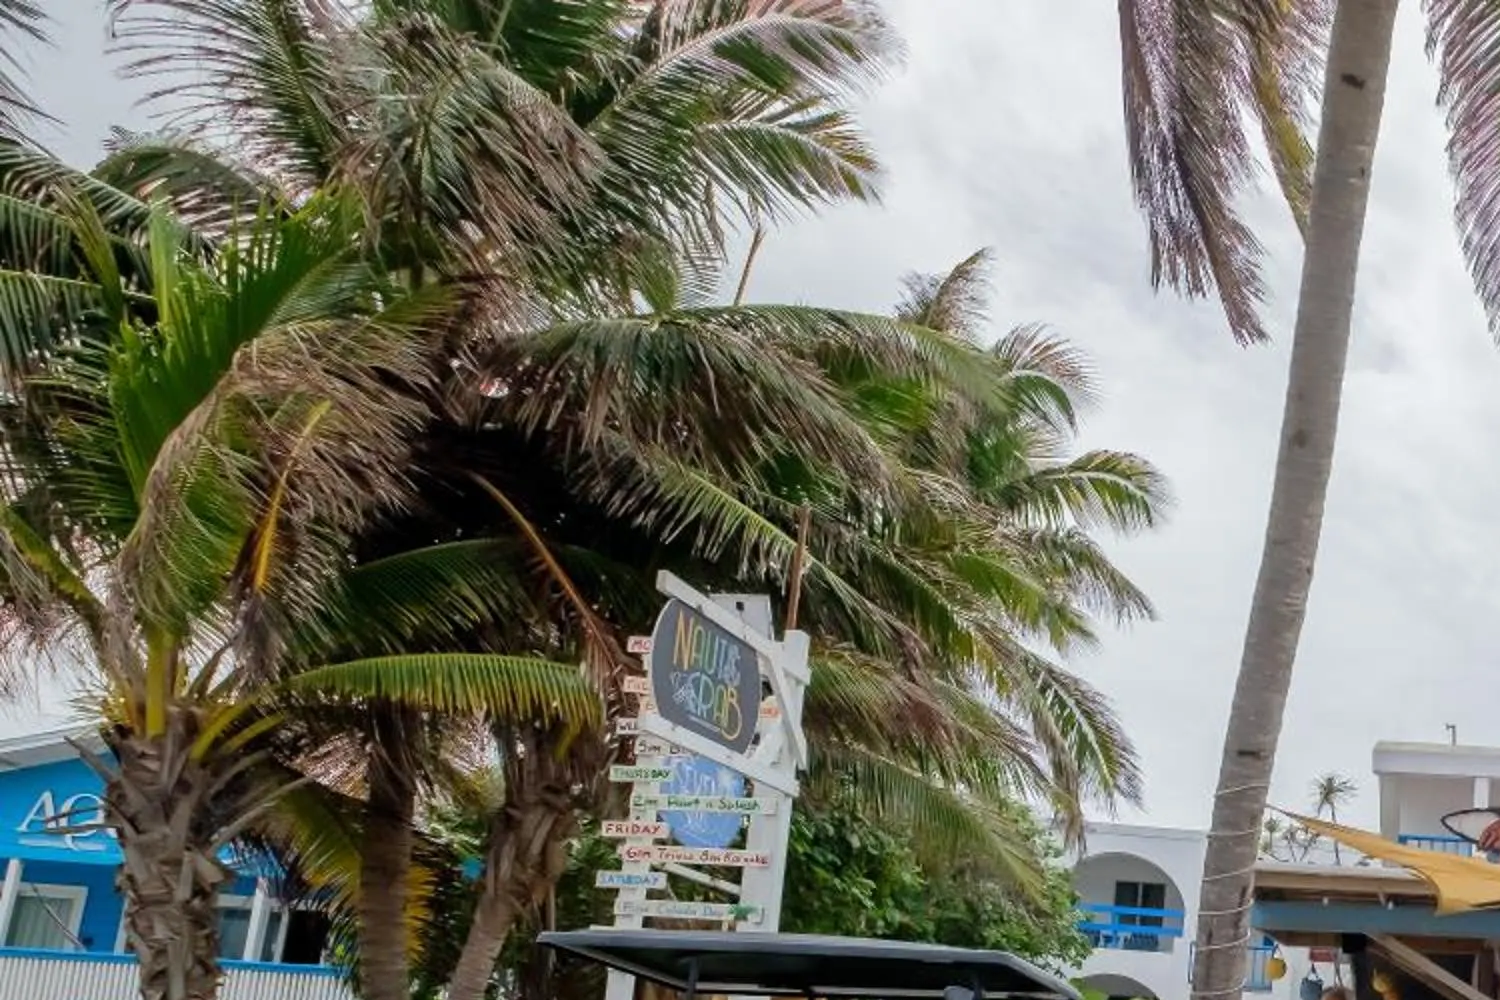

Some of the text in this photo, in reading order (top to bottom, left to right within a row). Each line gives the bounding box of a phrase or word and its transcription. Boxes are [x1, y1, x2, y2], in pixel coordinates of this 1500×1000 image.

[16, 791, 119, 851] AQ
[605, 823, 661, 836] FRIDAY
[600, 874, 660, 887] SATURDAY
